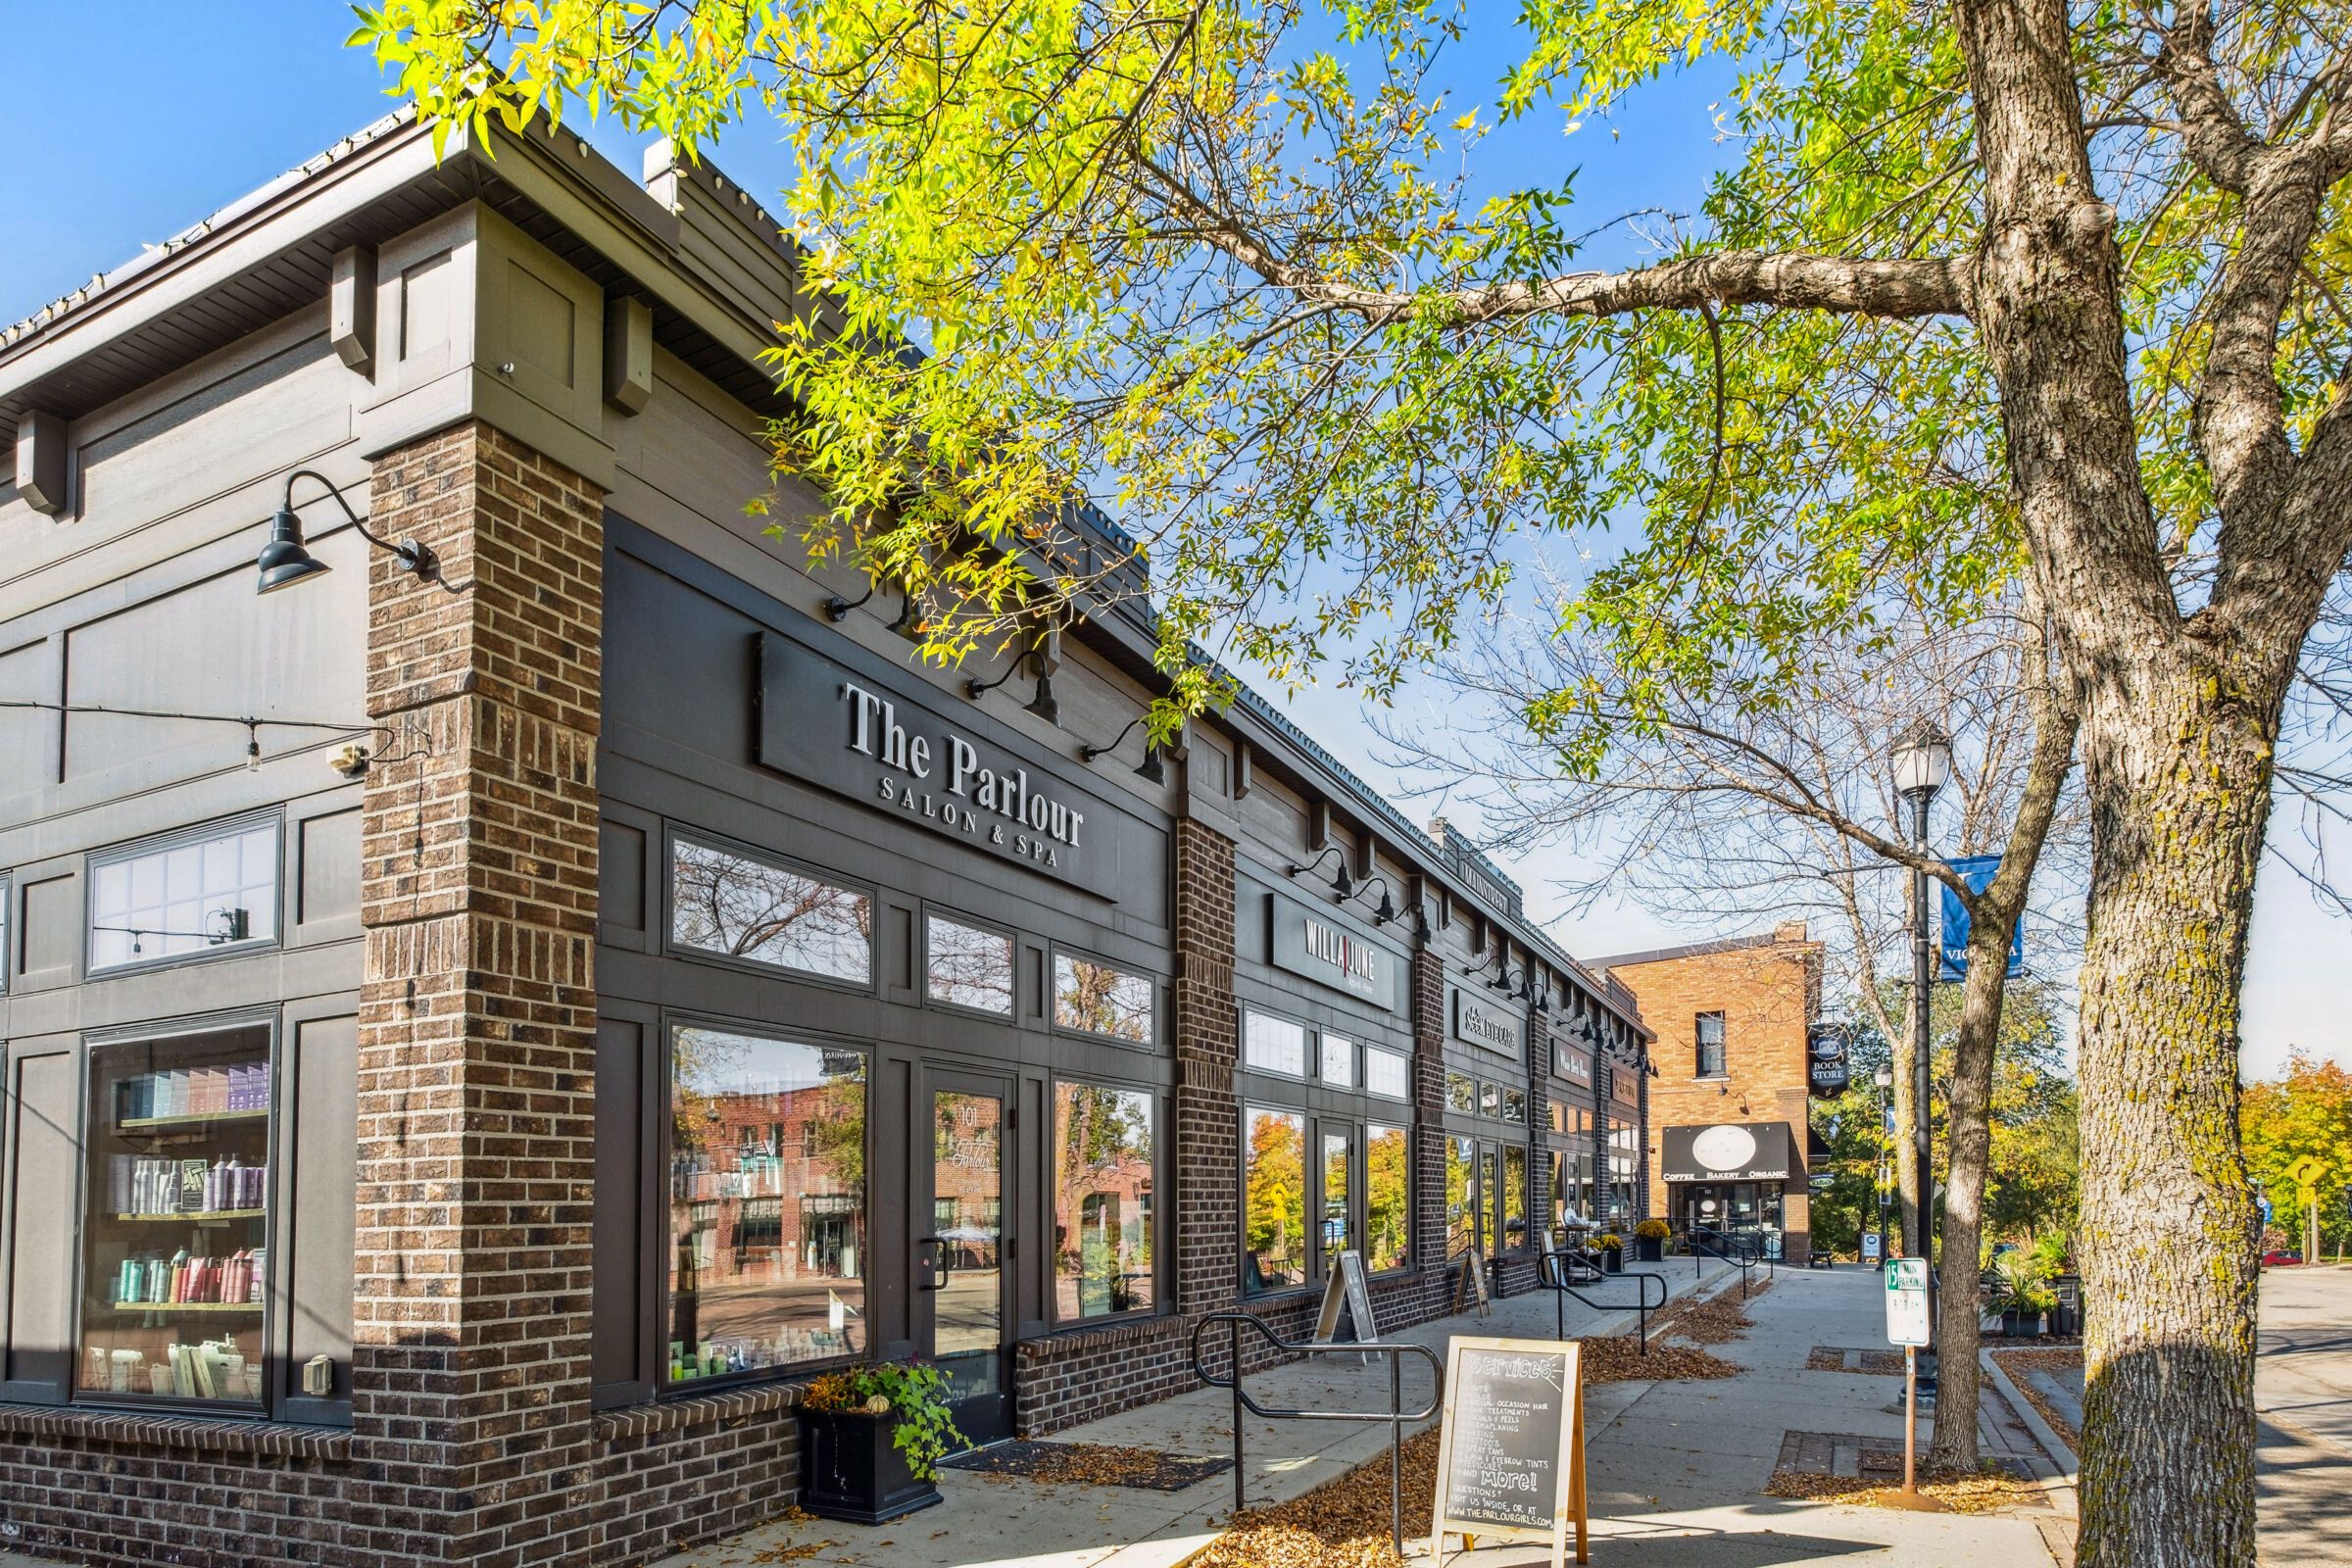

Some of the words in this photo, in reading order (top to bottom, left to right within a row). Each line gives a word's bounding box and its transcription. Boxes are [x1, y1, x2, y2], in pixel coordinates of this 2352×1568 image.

[846, 681, 931, 779] The
[948, 734, 1084, 848] Parlour
[879, 776, 977, 834] SALON
[992, 824, 1004, 845] &
[1015, 834, 1057, 867] SPA
[1305, 918, 1345, 968] WILLA
[1348, 941, 1374, 981] JUNE
[1814, 1060, 1842, 1070] BOOK
[1812, 1070, 1844, 1080] STORE
[960, 1105, 978, 1127] 101
[1886, 1264, 1897, 1286] 15
[1903, 1264, 1917, 1274] MIN
[1898, 1277, 1924, 1288] PARKING
[1496, 1400, 1530, 1409] OCCASION
[1533, 1402, 1548, 1411] HAIR
[1488, 1407, 1530, 1417] TREATMENTS
[1500, 1415, 1520, 1424] PEELS
[1488, 1446, 1504, 1456] TANS
[1492, 1456, 1523, 1466] EYEBROW
[1525, 1459, 1548, 1469] TINTS
[1470, 1497, 1480, 1506] US
[1512, 1503, 1524, 1514] OR
[1528, 1506, 1538, 1516] AT
